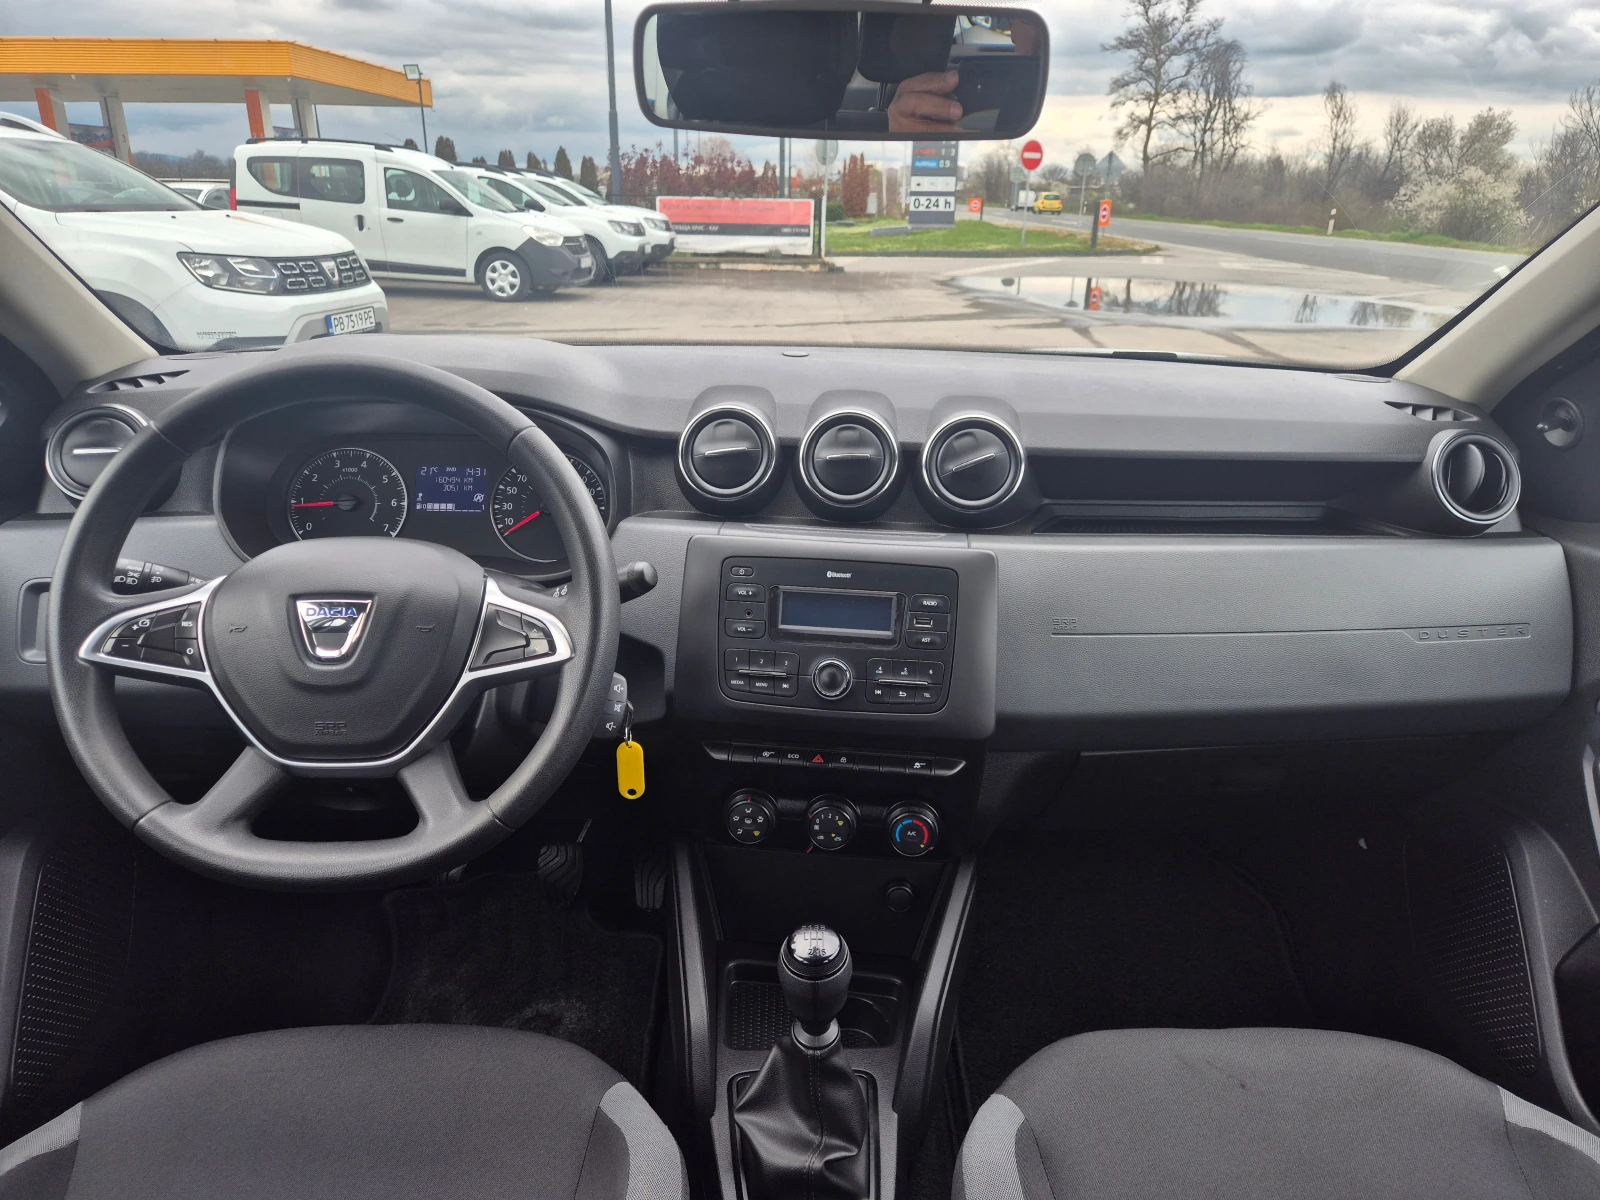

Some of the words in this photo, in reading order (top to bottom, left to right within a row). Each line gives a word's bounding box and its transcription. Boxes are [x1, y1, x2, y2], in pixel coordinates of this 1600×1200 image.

[914, 198, 940, 209] 0-24
[944, 198, 951, 209] h
[345, 312, 363, 330] 7519
[364, 310, 374, 325] PE
[516, 474, 528, 482] 70
[306, 607, 358, 618] DACIA
[1419, 626, 1526, 640] DUSTER
